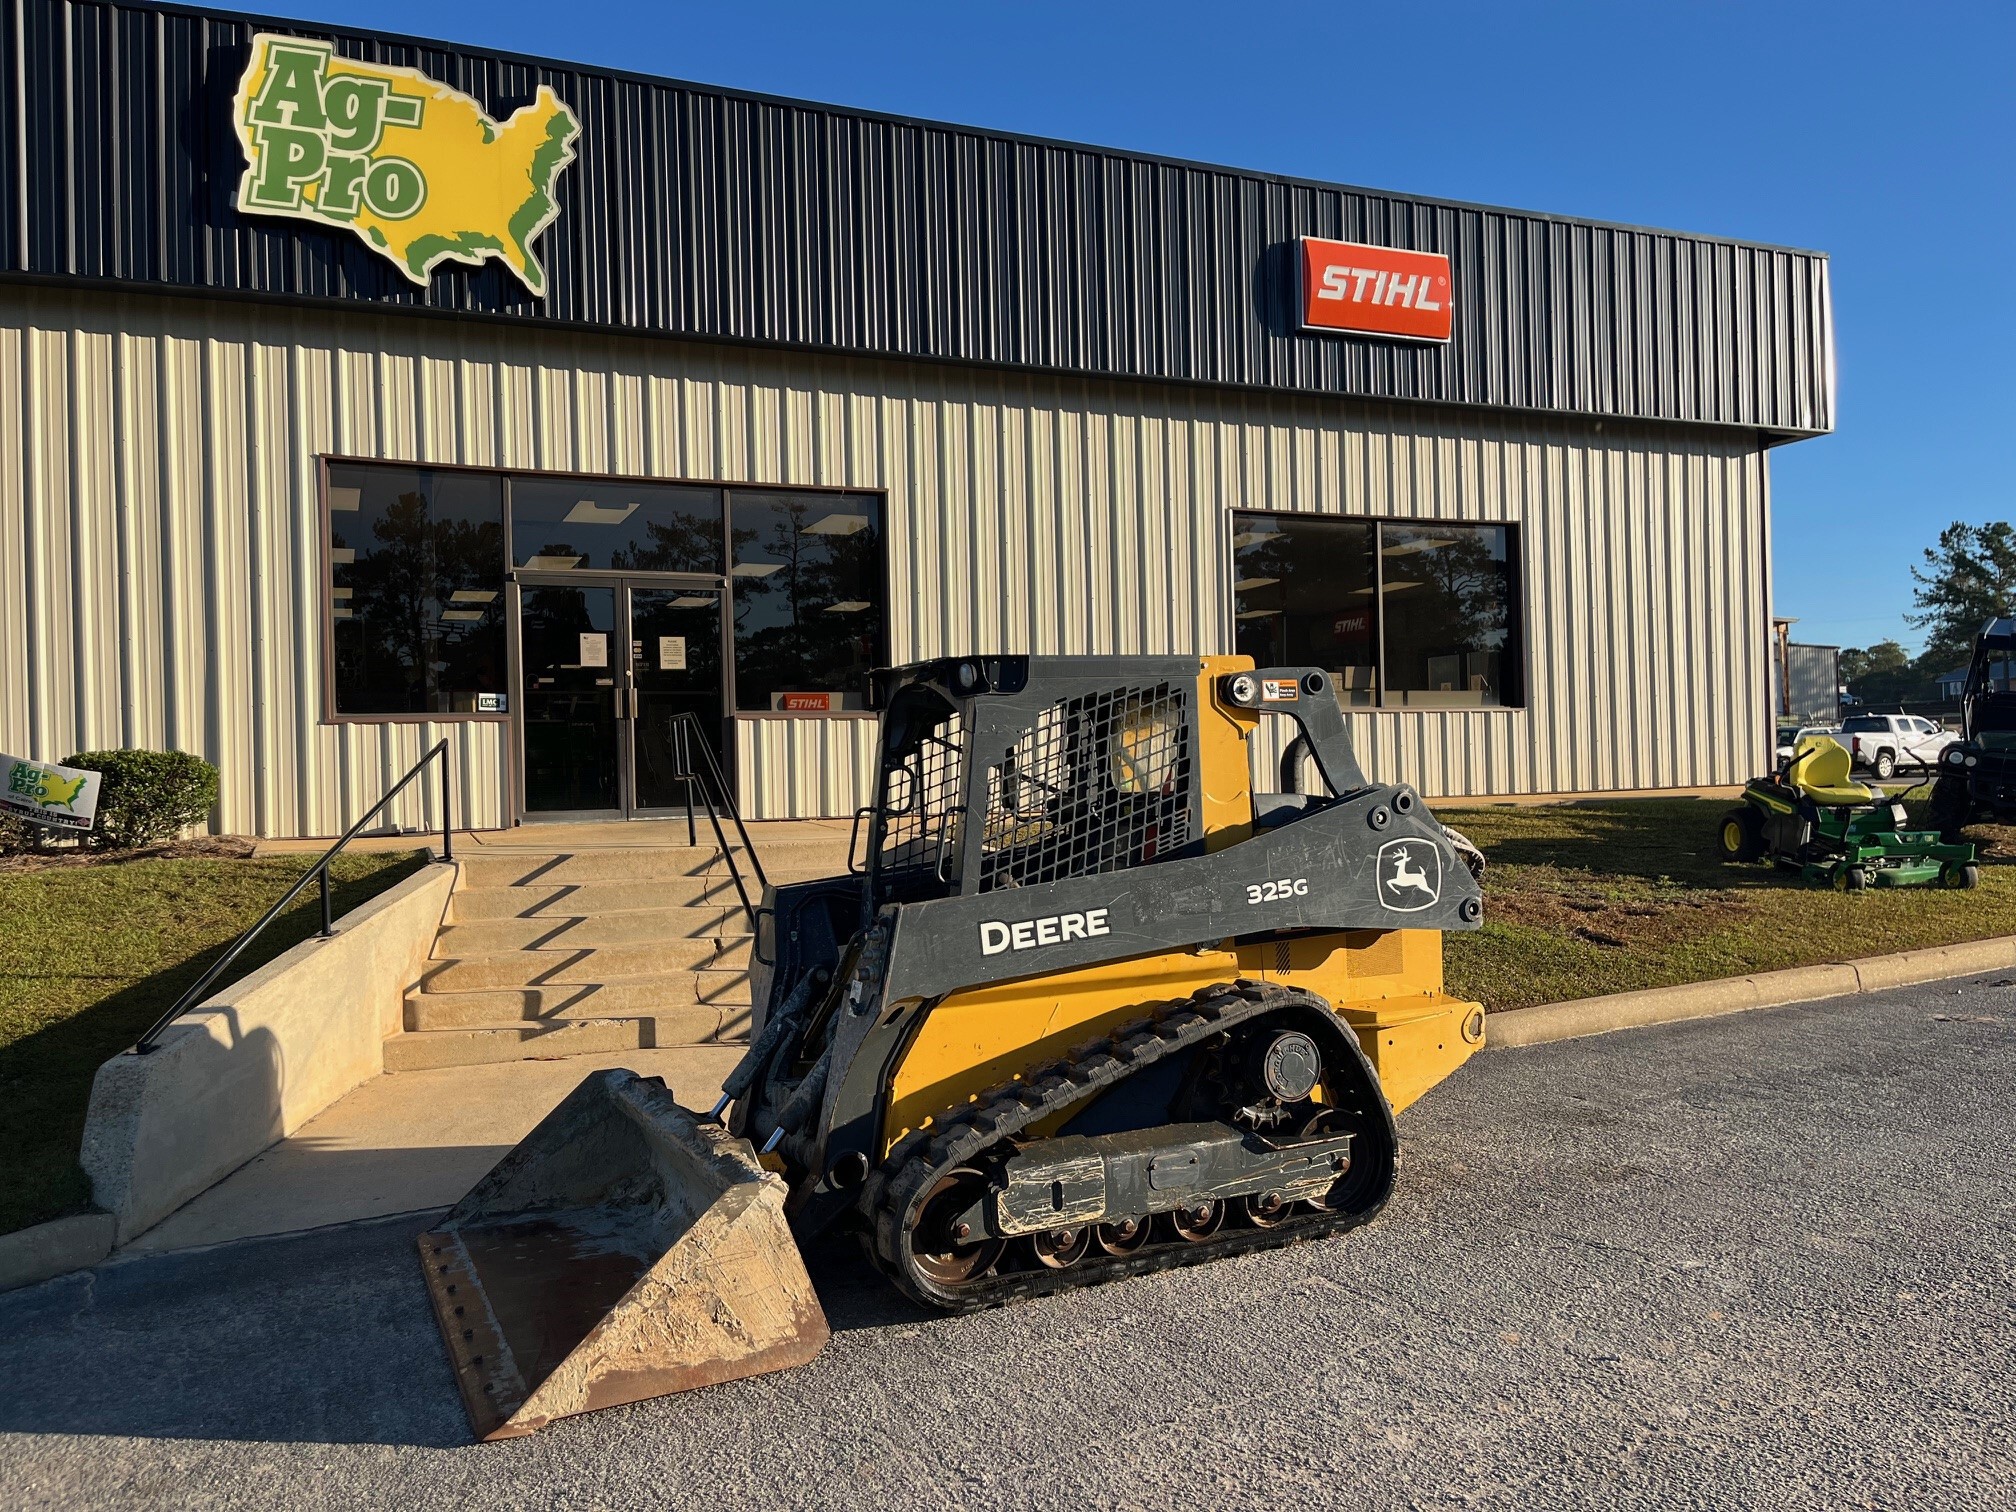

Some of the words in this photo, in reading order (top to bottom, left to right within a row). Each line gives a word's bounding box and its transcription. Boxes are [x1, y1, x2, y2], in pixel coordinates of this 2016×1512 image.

[249, 45, 421, 153] Ag-
[252, 126, 425, 218] Pro
[1317, 264, 1440, 312] STIHL
[1334, 617, 1366, 634] STIHL
[788, 698, 825, 709] STIHL
[11, 762, 50, 783] Ag-
[11, 777, 48, 797] Pro
[1246, 878, 1308, 905] 325G
[980, 908, 1110, 955] DEERE
